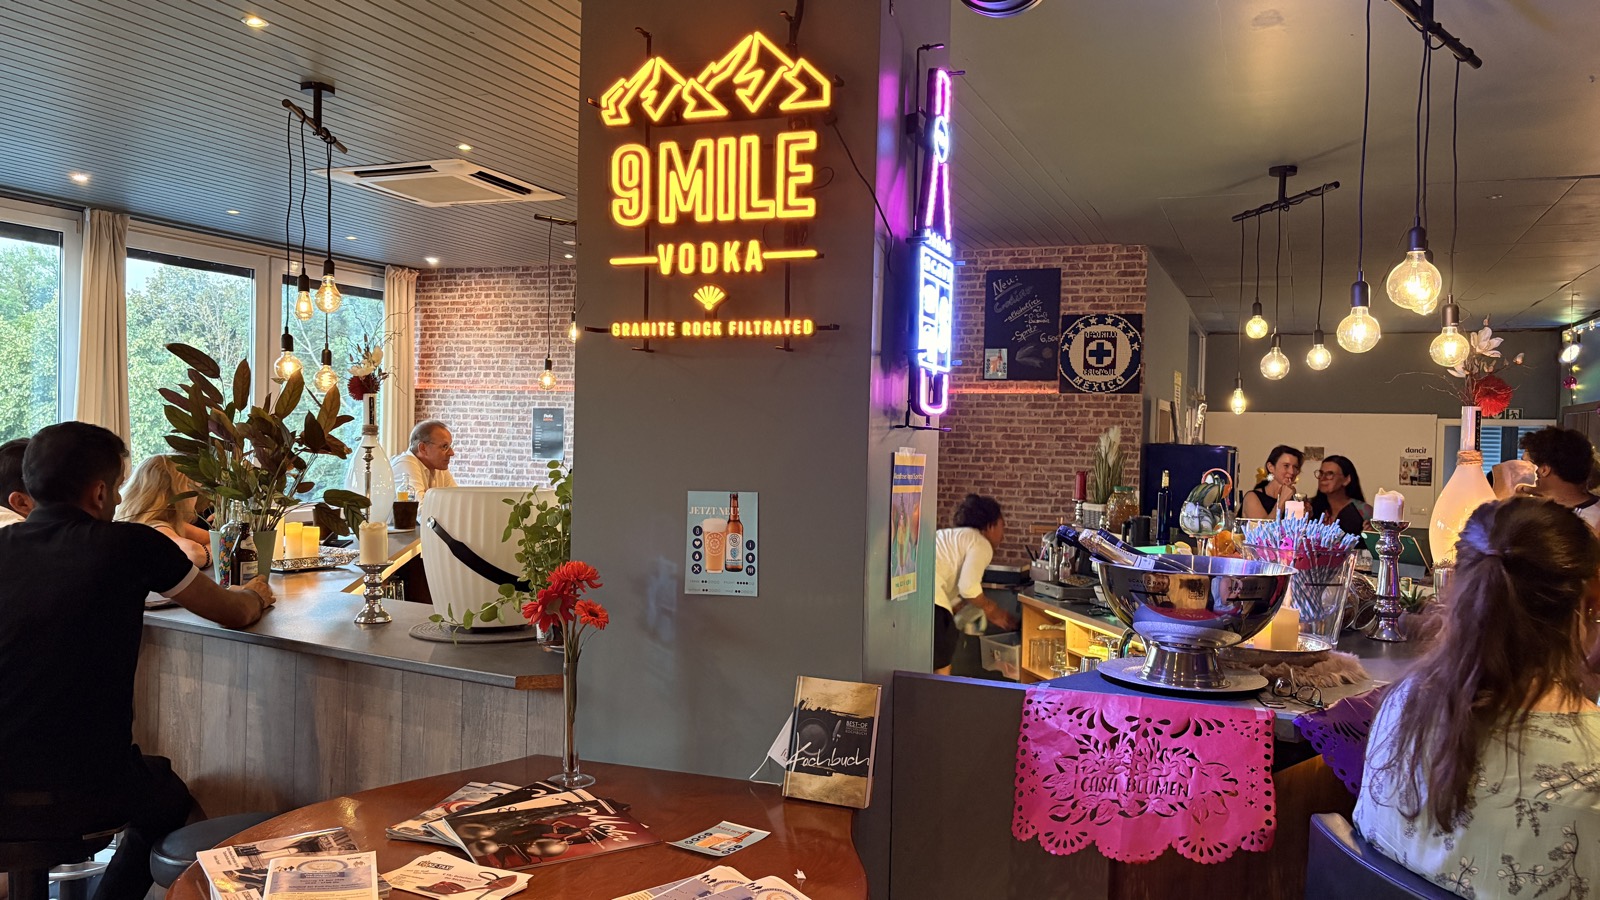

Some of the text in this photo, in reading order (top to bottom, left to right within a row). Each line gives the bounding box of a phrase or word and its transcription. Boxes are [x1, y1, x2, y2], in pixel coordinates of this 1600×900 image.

[611, 131, 816, 226] 9 MILE
[657, 239, 764, 275] VODKA
[611, 319, 814, 337] GRANITE ROCK FILTRATED
[1073, 376, 1125, 391] MEXICO
[689, 506, 717, 515] JETZT
[786, 731, 870, 772] Kochbuch
[1080, 776, 1189, 797] CASA BLUMEN
